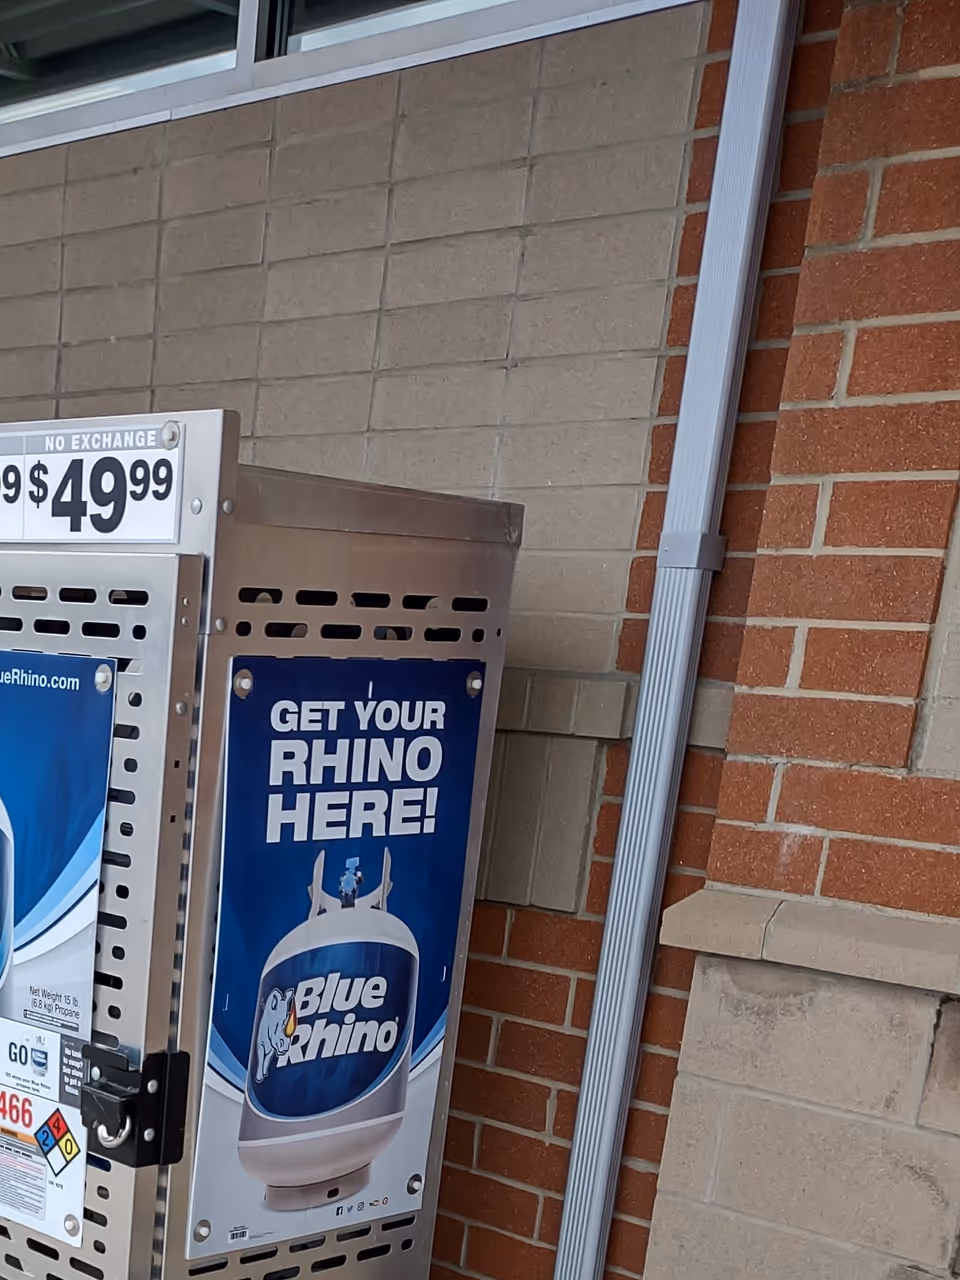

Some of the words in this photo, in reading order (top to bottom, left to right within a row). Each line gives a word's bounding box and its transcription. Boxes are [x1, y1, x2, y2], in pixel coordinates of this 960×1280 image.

[45, 435, 65, 451] NO
[71, 430, 157, 450] EXCHANGE
[270, 700, 345, 732] GET
[358, 699, 446, 731] YOUR
[269, 736, 443, 786] RHINO
[266, 787, 438, 843] HERE!
[30, 986, 40, 996] Net
[41, 988, 62, 1003] Weight
[64, 995, 71, 1005] 15
[294, 973, 388, 1016] Blue
[55, 1003, 80, 1020] Propane
[277, 1015, 399, 1068] Rhino
[8, 1042, 28, 1067] GO
[52, 1118, 61, 1134] 4
[41, 1130, 50, 1147] 2
[64, 1138, 73, 1156] 0
